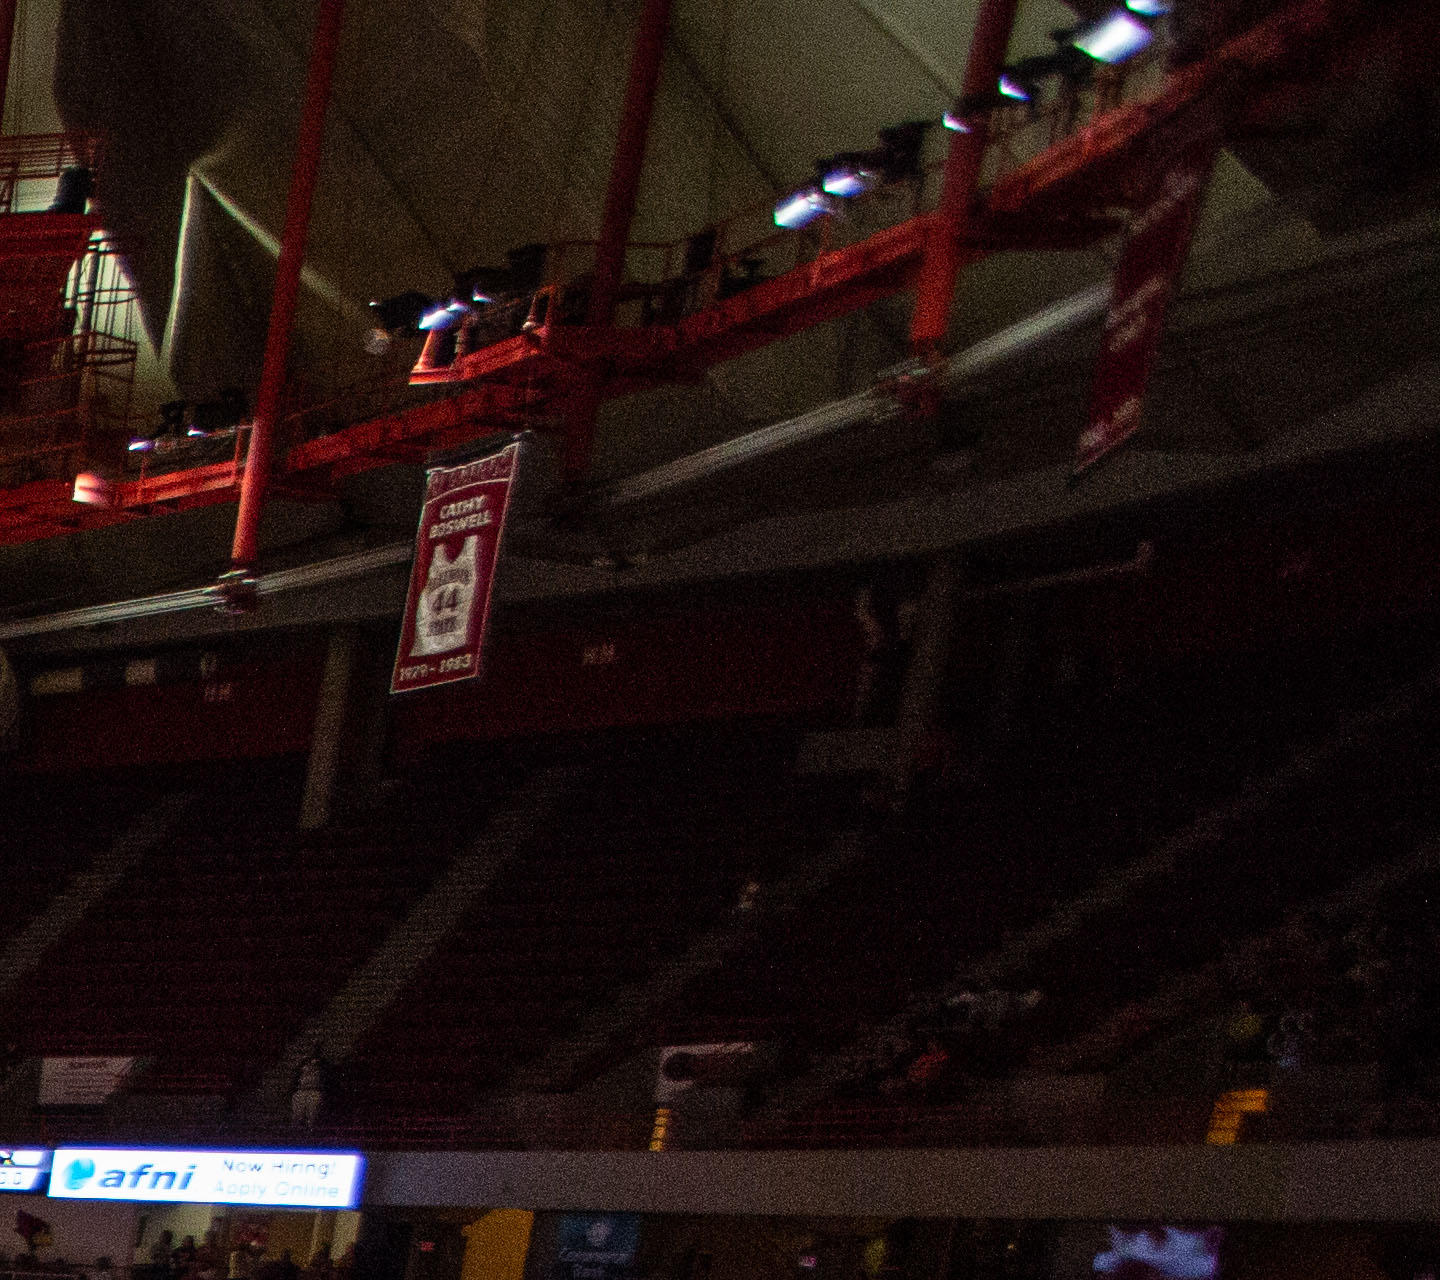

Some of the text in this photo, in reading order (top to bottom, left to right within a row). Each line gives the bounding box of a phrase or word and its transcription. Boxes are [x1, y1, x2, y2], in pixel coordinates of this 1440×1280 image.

[96, 1162, 198, 1192] afni
[222, 1159, 337, 1179] Now Hiring!
[213, 1180, 340, 1200] Apply Online
